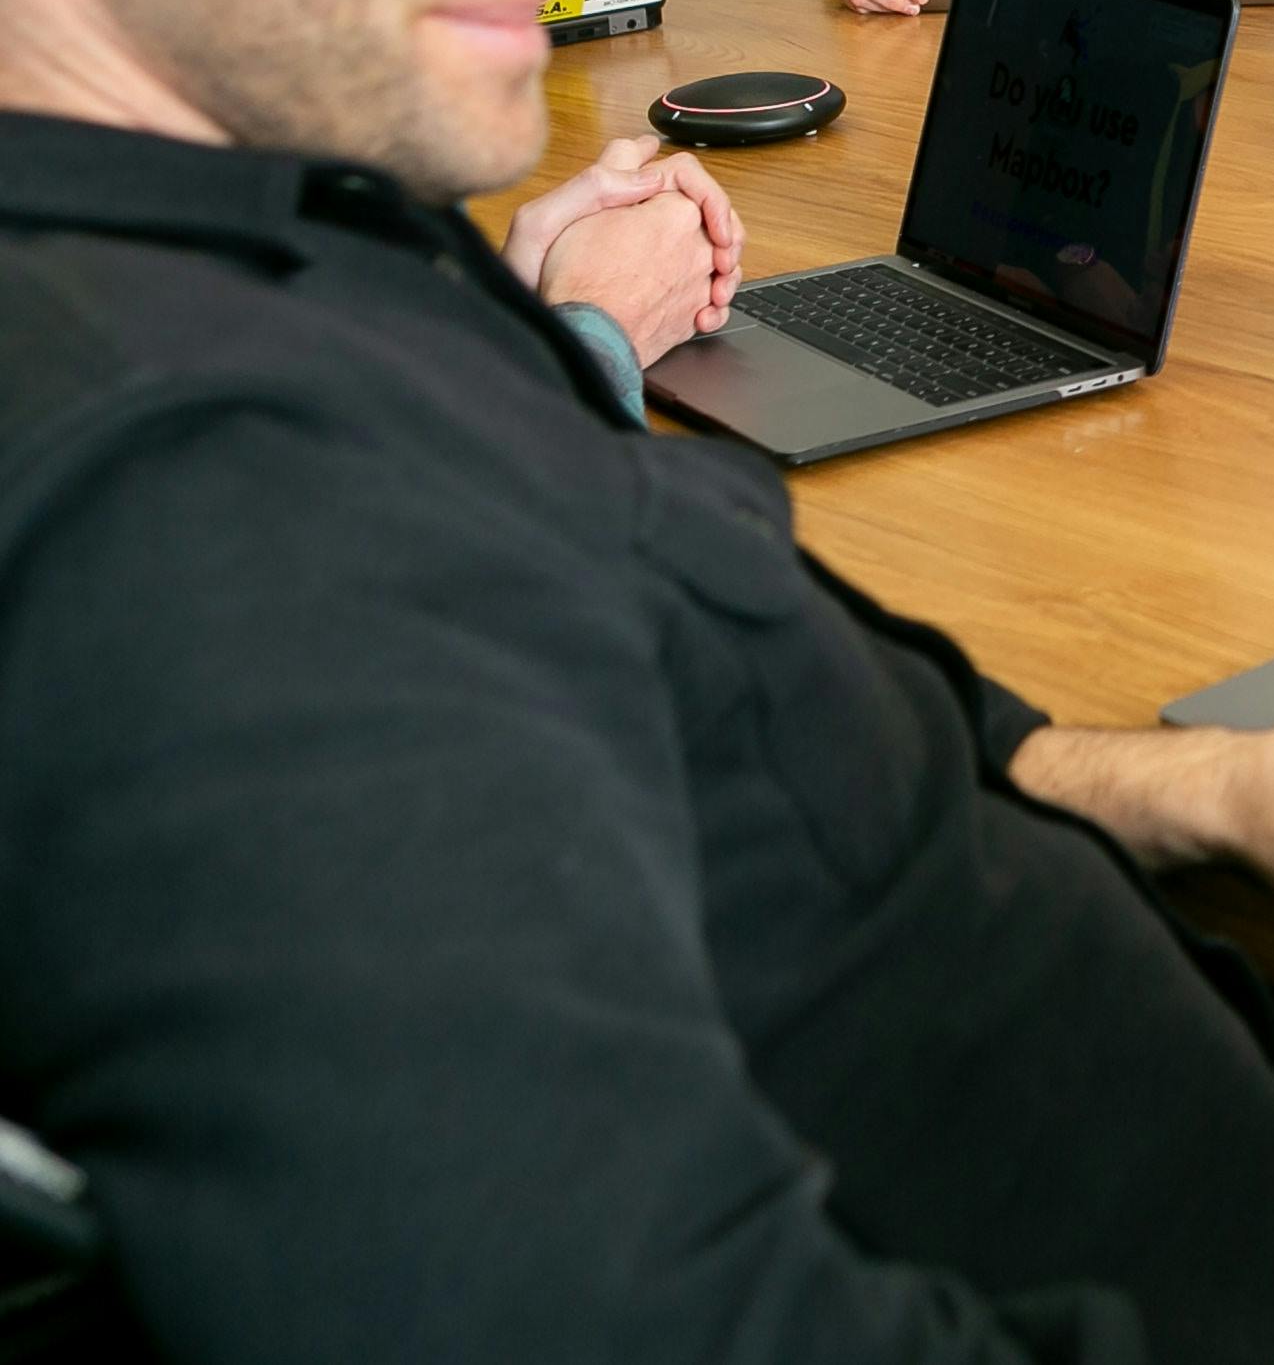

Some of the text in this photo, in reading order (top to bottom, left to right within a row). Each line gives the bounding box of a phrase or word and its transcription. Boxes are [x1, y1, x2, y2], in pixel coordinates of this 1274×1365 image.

[989, 61, 1026, 107] Do
[1089, 103, 1140, 147] use
[987, 131, 1112, 209] Mapbox?
